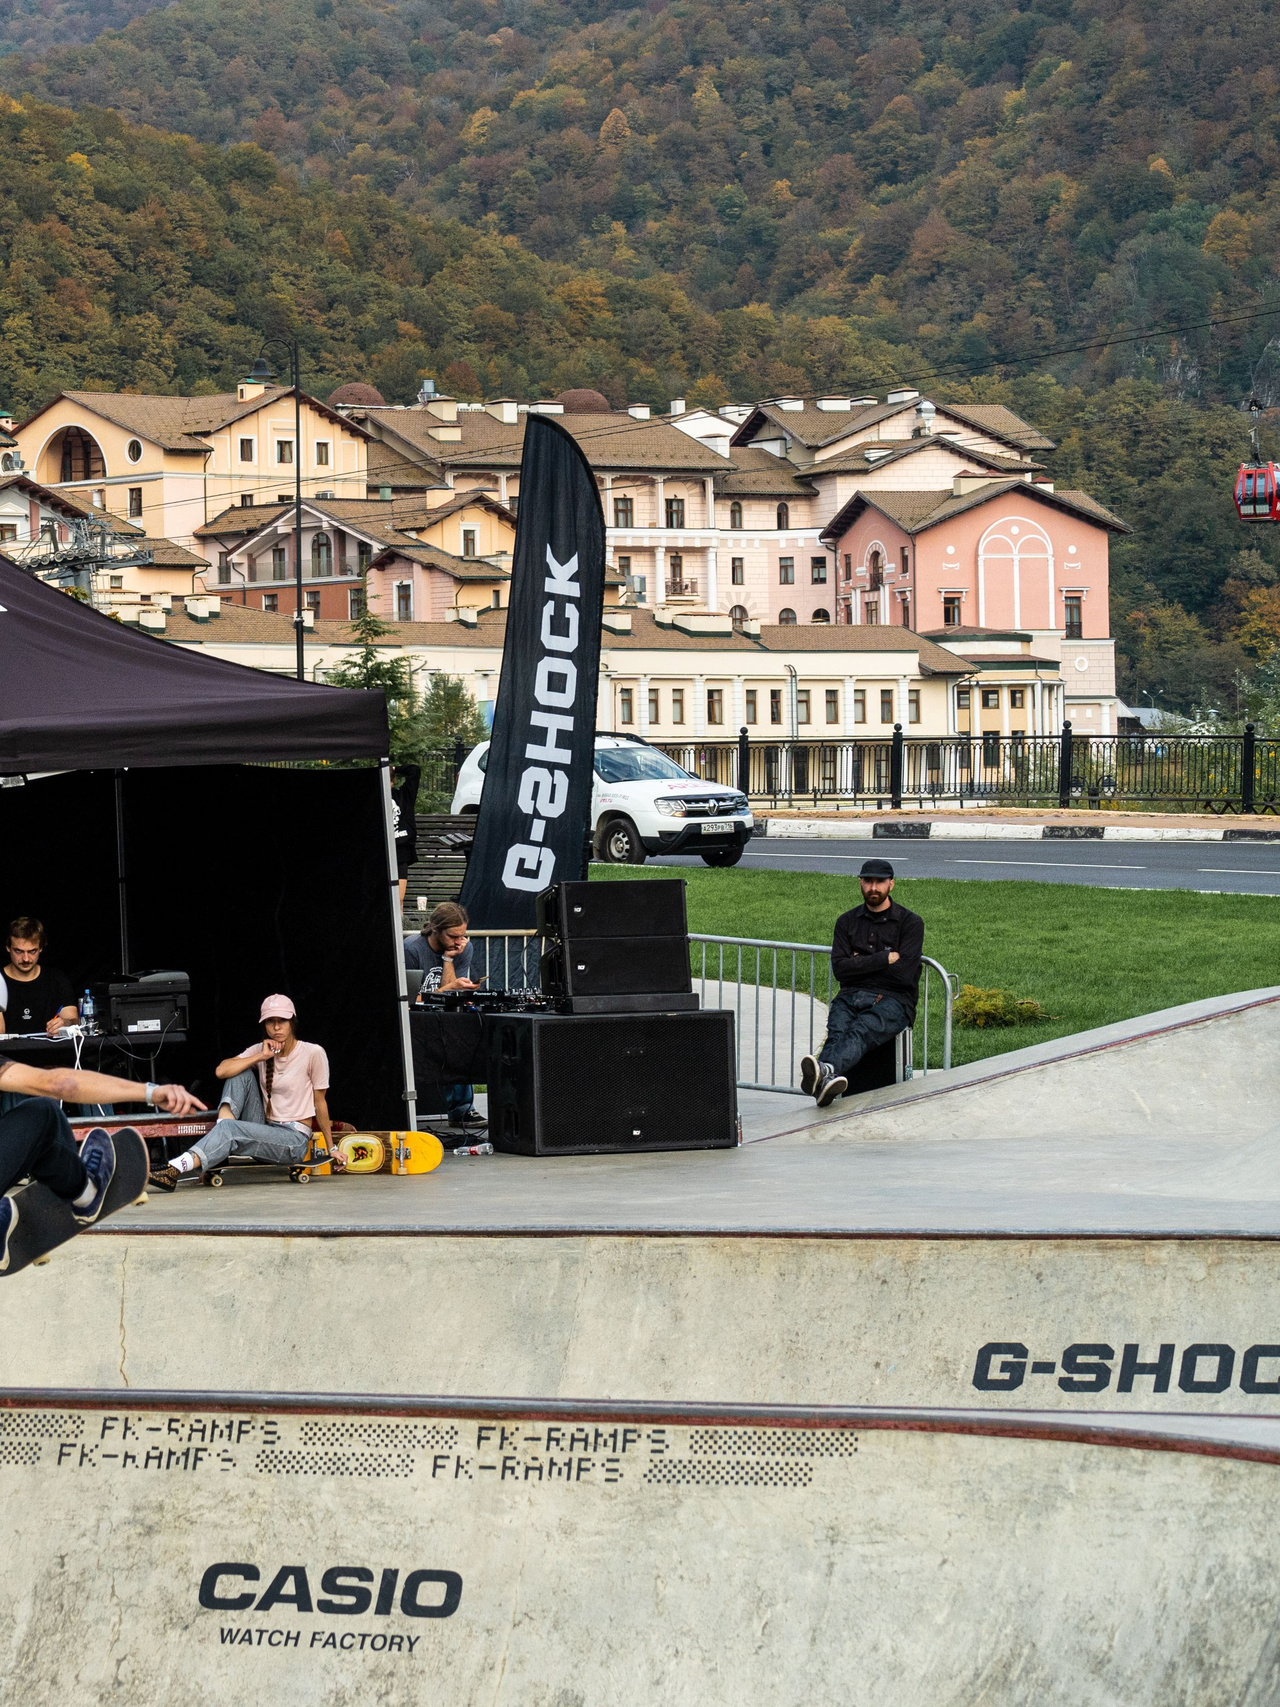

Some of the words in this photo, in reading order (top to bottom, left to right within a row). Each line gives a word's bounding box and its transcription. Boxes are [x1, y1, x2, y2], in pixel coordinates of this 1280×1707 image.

[501, 543, 581, 893] G-SHOCK
[100, 1416, 281, 1444] FK-RAMPS
[477, 1426, 670, 1454] FK-RAMPS
[432, 1455, 624, 1483] FK-RAMPS
[198, 1562, 463, 1618] CASIO
[220, 1627, 301, 1647] WATCH
[309, 1630, 421, 1654] FACTORY
